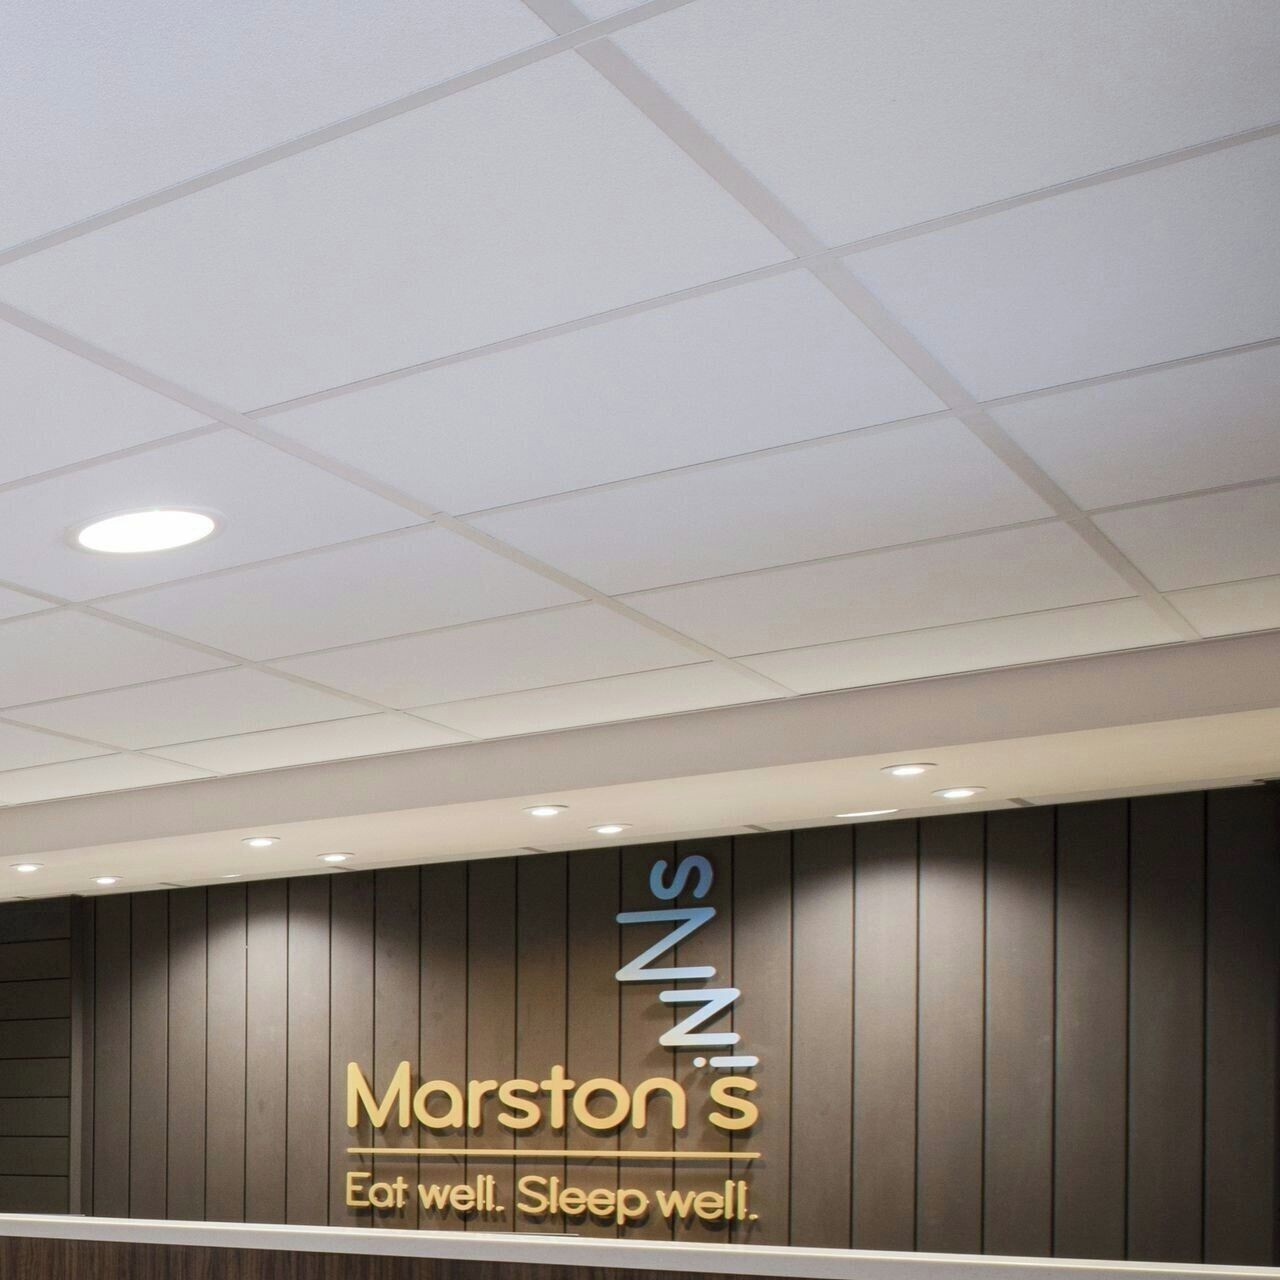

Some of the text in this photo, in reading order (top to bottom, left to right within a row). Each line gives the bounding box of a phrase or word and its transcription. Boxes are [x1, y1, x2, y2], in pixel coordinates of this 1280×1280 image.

[346, 1171, 759, 1226] Eat well. Sleep well.
